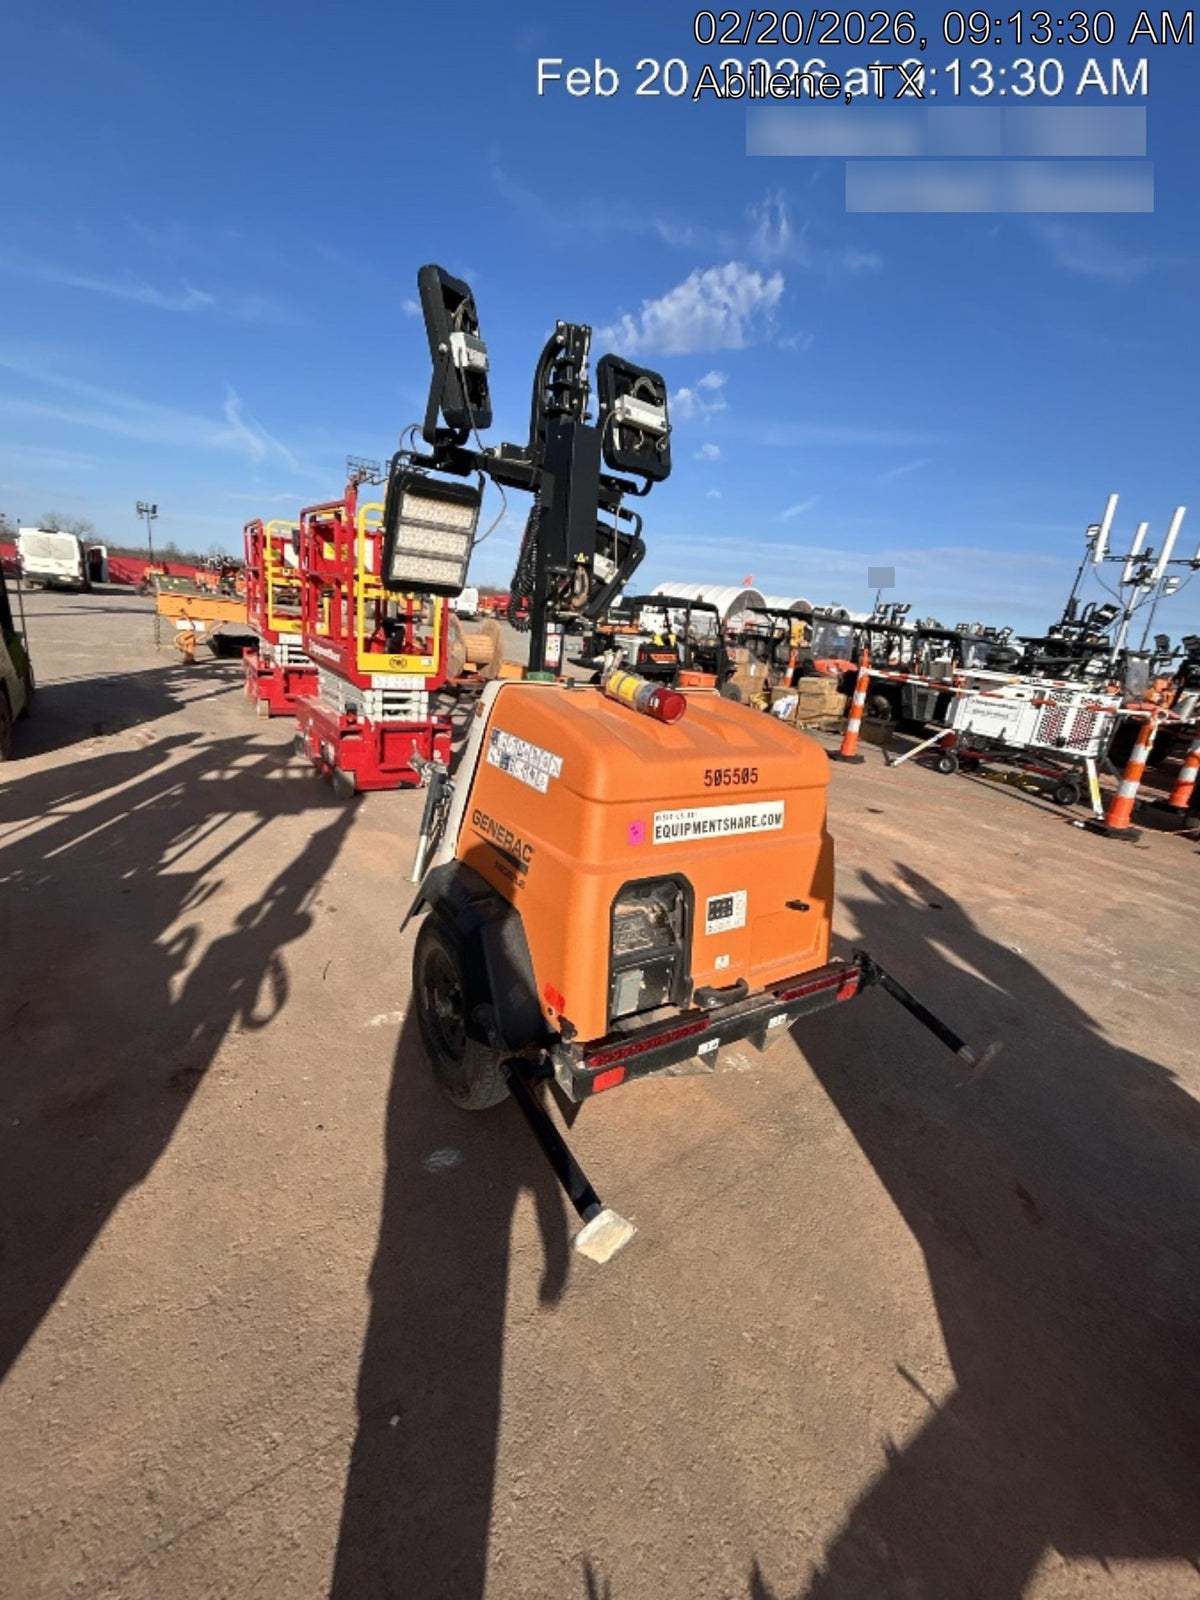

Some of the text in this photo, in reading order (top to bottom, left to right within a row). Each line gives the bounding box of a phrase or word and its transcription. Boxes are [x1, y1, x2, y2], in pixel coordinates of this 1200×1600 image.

[703, 767, 759, 787] 505505
[472, 808, 535, 863] GENERAC
[655, 812, 783, 840] EQUIPMENTSHARE.COM
